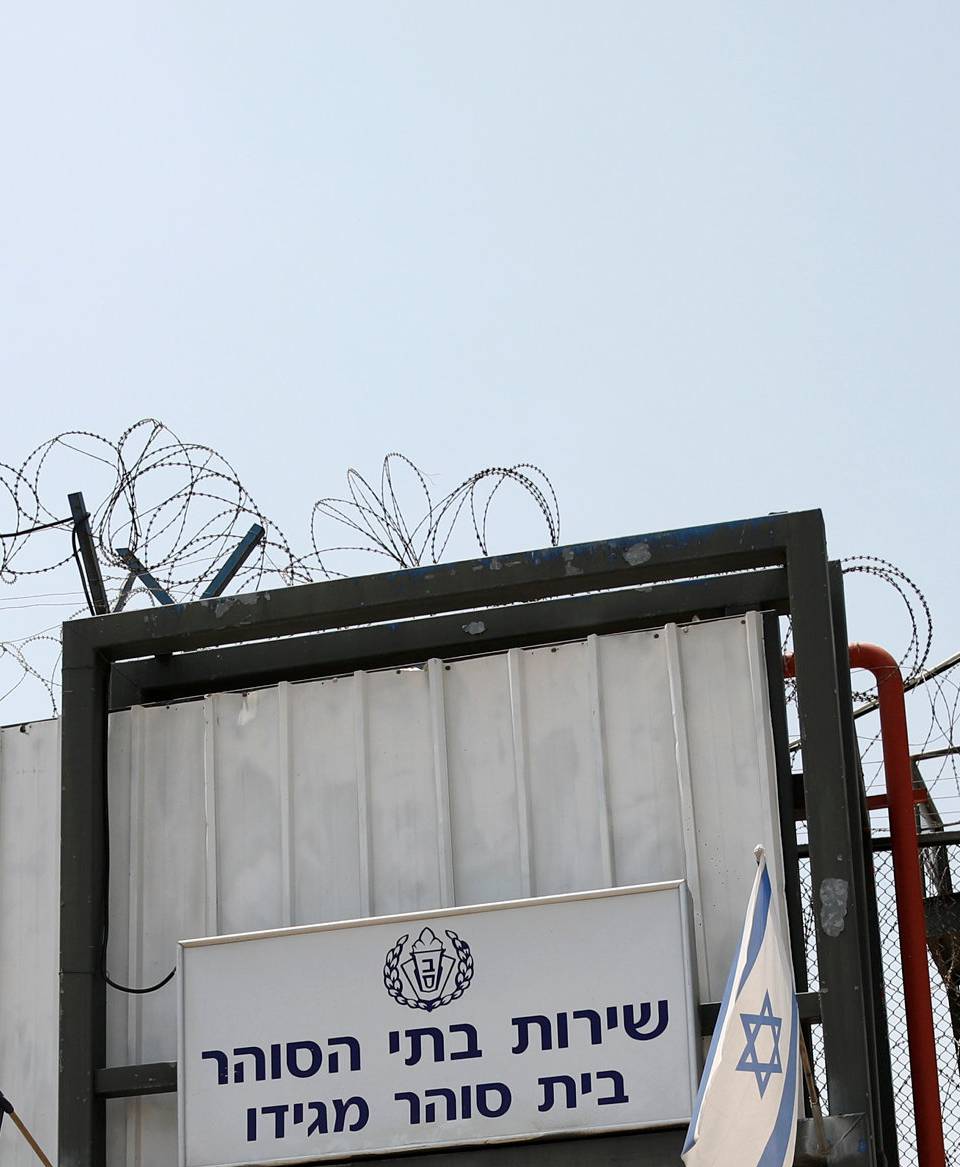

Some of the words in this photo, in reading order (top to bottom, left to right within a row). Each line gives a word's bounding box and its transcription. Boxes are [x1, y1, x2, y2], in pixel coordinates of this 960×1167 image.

[389, 1024, 482, 1066] בתי
[512, 1000, 668, 1054] שירות
[202, 1037, 360, 1085] הסוהר
[395, 1083, 511, 1124] סוהר
[538, 1070, 629, 1112] בית
[247, 1097, 369, 1141] מגידו
